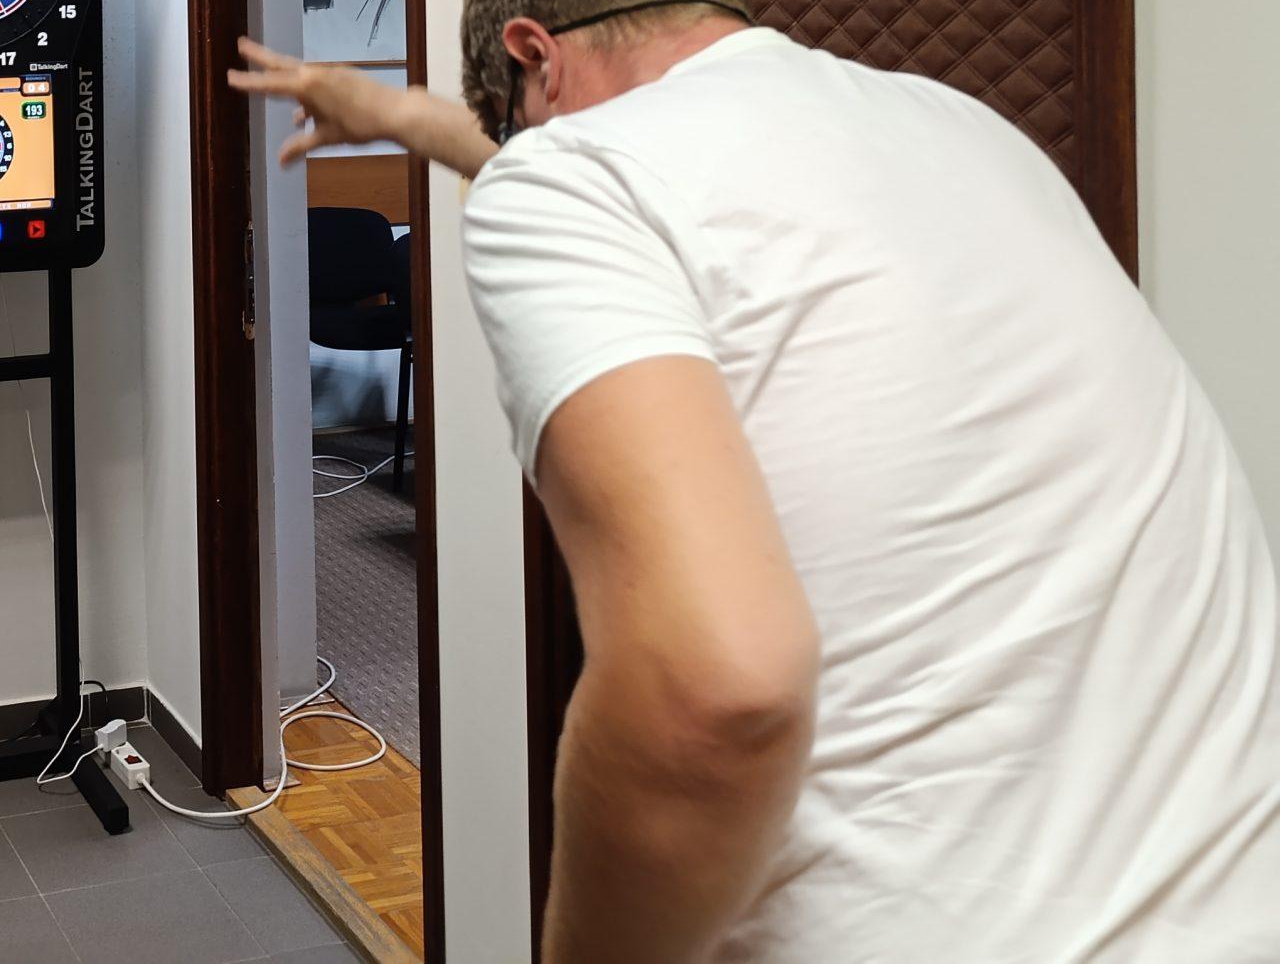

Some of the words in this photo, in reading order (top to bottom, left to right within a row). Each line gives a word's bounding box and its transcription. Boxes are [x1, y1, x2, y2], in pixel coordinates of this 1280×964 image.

[58, 5, 76, 18] 15
[37, 32, 48, 45] 2
[25, 105, 43, 116] 193
